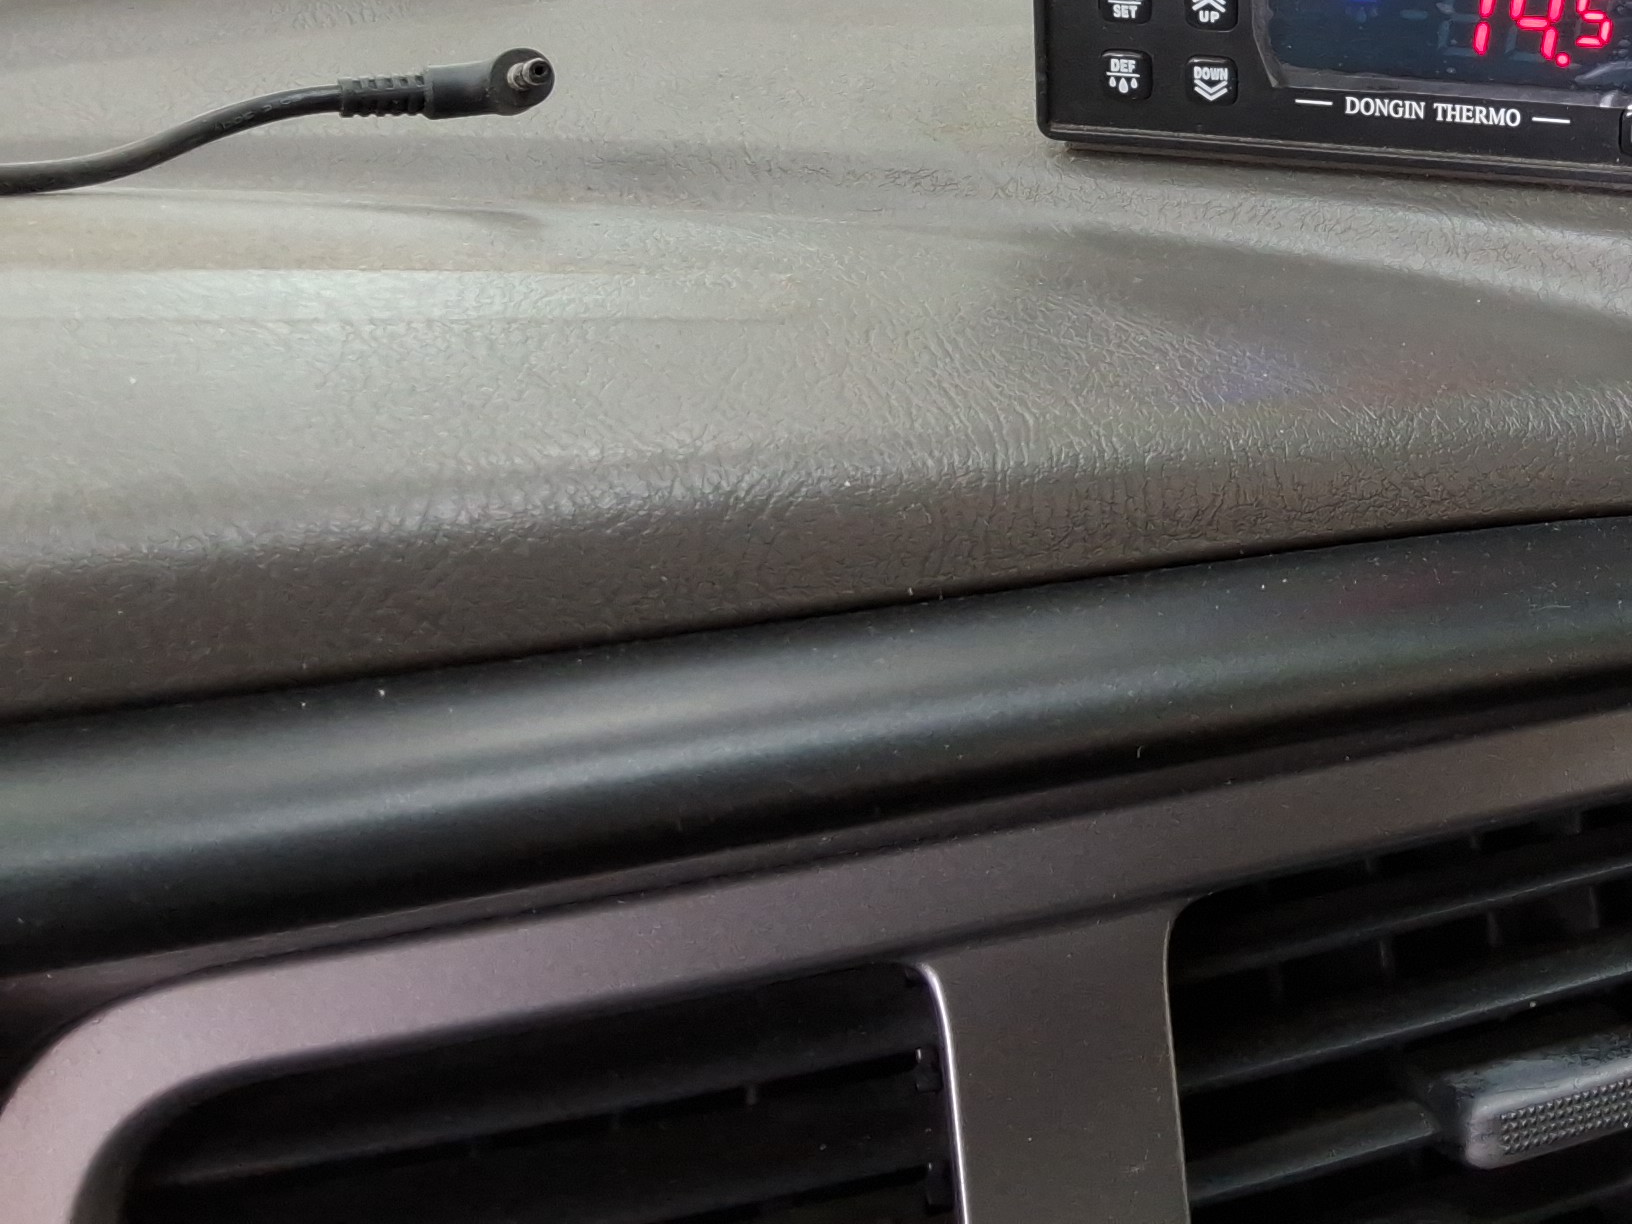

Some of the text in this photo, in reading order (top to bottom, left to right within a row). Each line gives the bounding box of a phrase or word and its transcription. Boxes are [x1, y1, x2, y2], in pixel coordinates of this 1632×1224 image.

[1113, 5, 1138, 19] SET
[1199, 11, 1220, 23] UP
[1110, 58, 1136, 72] DEF
[1193, 66, 1228, 80] DOWN
[1344, 96, 1521, 127] DONGIN THERMO
